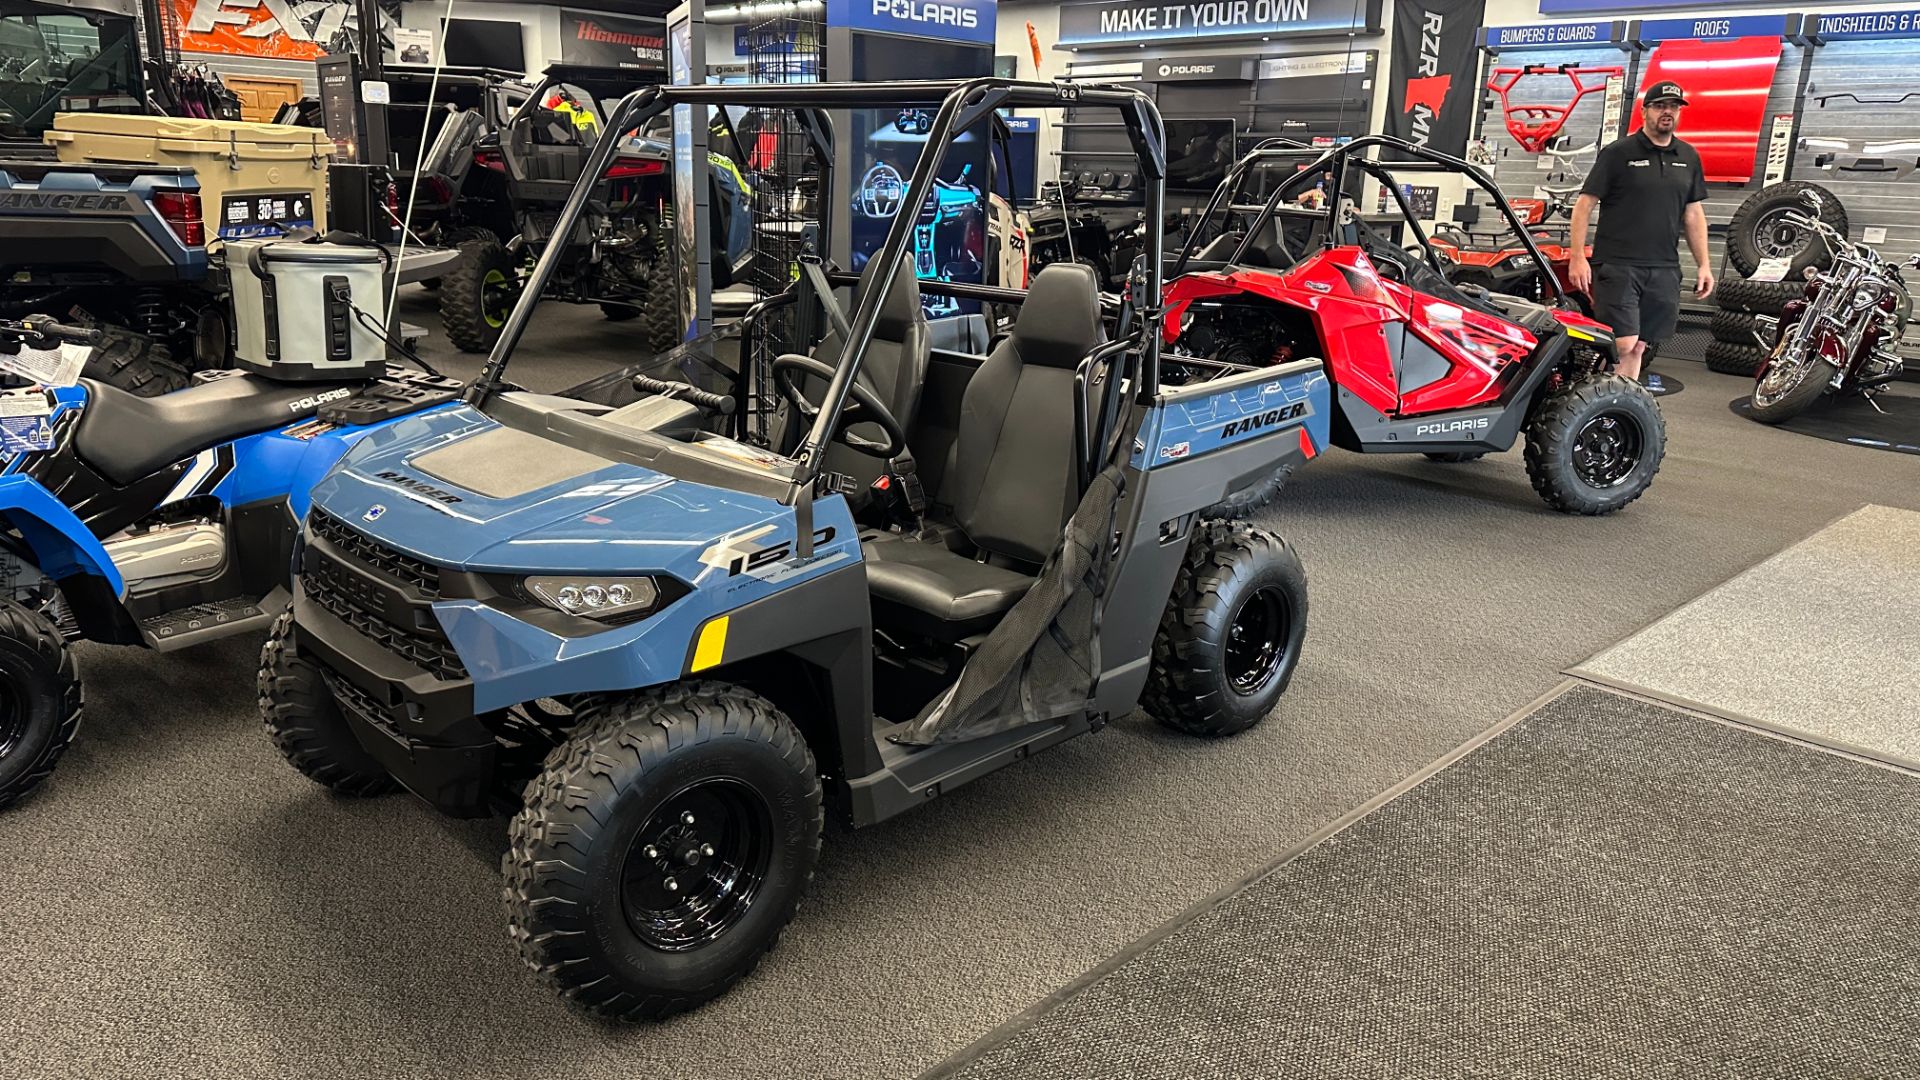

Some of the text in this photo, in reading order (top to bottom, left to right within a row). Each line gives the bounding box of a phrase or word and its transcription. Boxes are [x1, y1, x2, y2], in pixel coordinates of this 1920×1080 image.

[872, 0, 978, 28] POLARIS
[1100, 0, 1309, 34] MAKE IT YOUR OWN
[1817, 15, 1895, 34] INDSHIELDS
[1899, 14, 1910, 31] &
[1500, 25, 1597, 44] BUMPERS & GUARDS
[1693, 20, 1730, 37] ROOFS
[1418, 10, 1443, 77] RZR
[1172, 65, 1215, 74] POLARIS
[0, 193, 127, 210] ANGER
[258, 204, 272, 220] 30
[288, 388, 351, 412] POLARIS
[1221, 402, 1304, 439] RANGER
[1416, 418, 1488, 435] POLARIS
[374, 471, 463, 504] RANGER
[729, 526, 836, 577] 150
